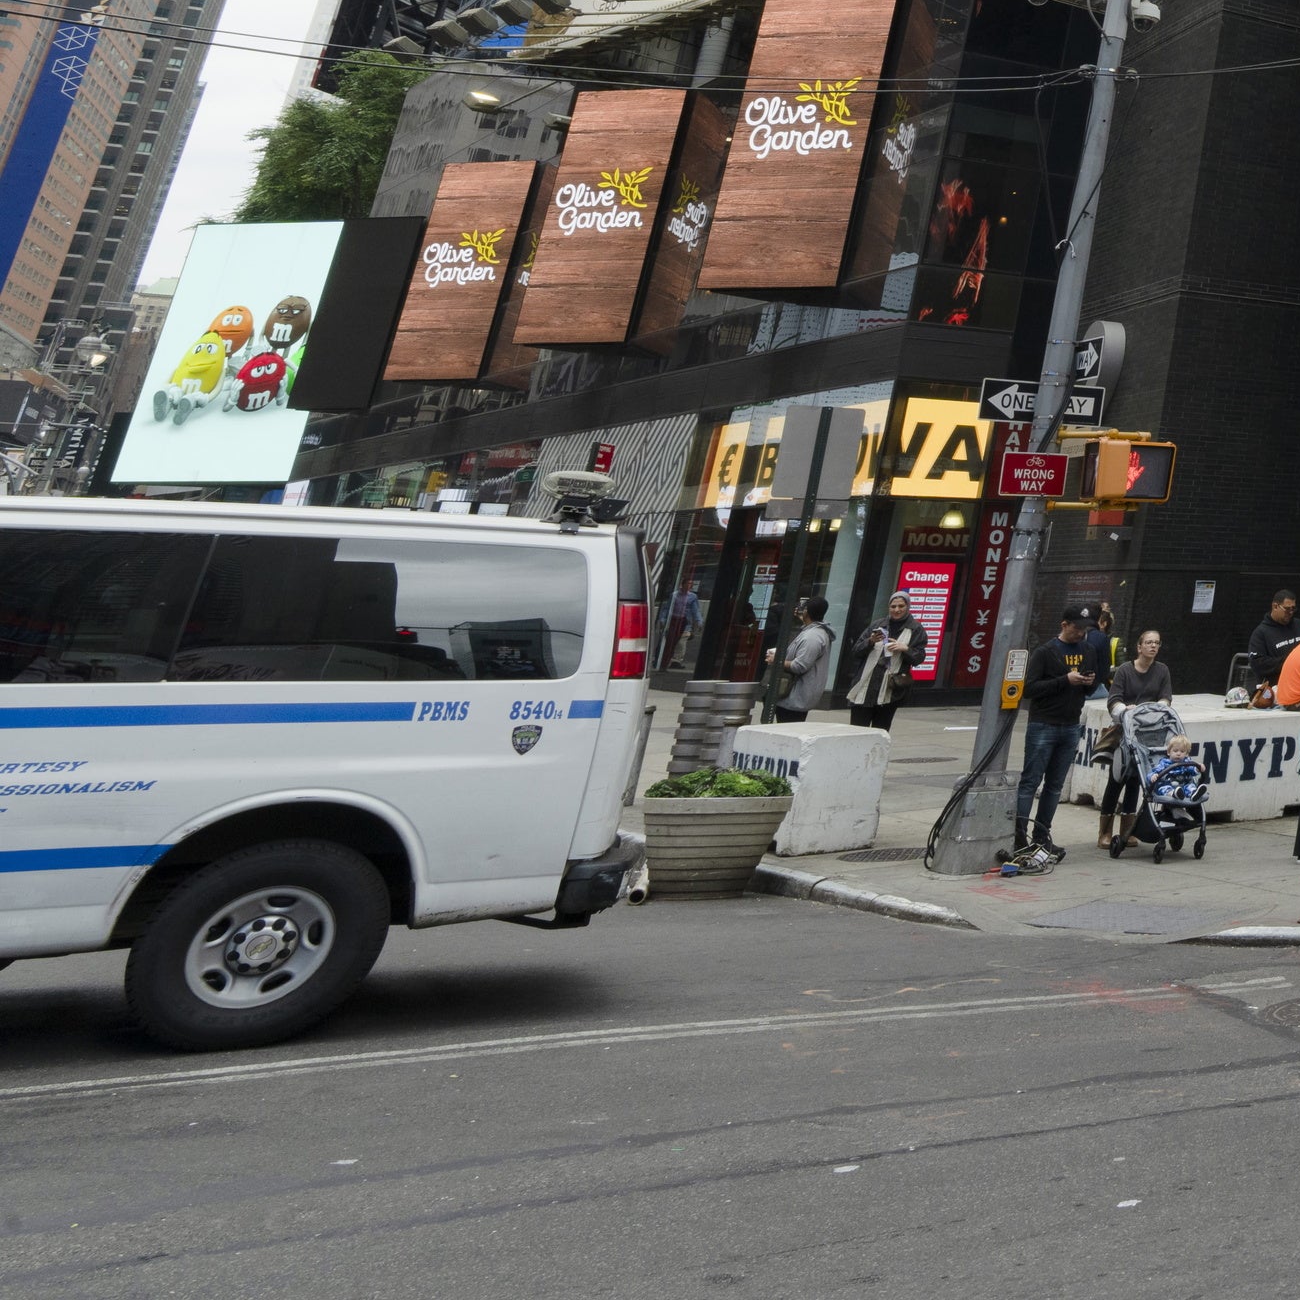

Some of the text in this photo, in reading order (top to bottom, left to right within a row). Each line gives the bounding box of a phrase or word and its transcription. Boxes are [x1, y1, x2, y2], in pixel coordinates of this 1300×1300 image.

[745, 96, 818, 126] Olive
[749, 123, 853, 160] Garden
[556, 183, 615, 208] Olive
[558, 205, 643, 235] Garden
[423, 242, 474, 265] Olive
[425, 261, 496, 288] Garden
[1077, 352, 1095, 367] WAY
[1000, 393, 1088, 414] ONE AY
[1013, 469, 1055, 480] WRONG
[1020, 480, 1046, 491] WAY
[981, 511, 1009, 601] MONEY
[905, 571, 950, 584] Change
[967, 655, 982, 673] $
[417, 700, 470, 722] PBMS
[509, 700, 556, 720] 8540
[1203, 736, 1298, 785] NYP
